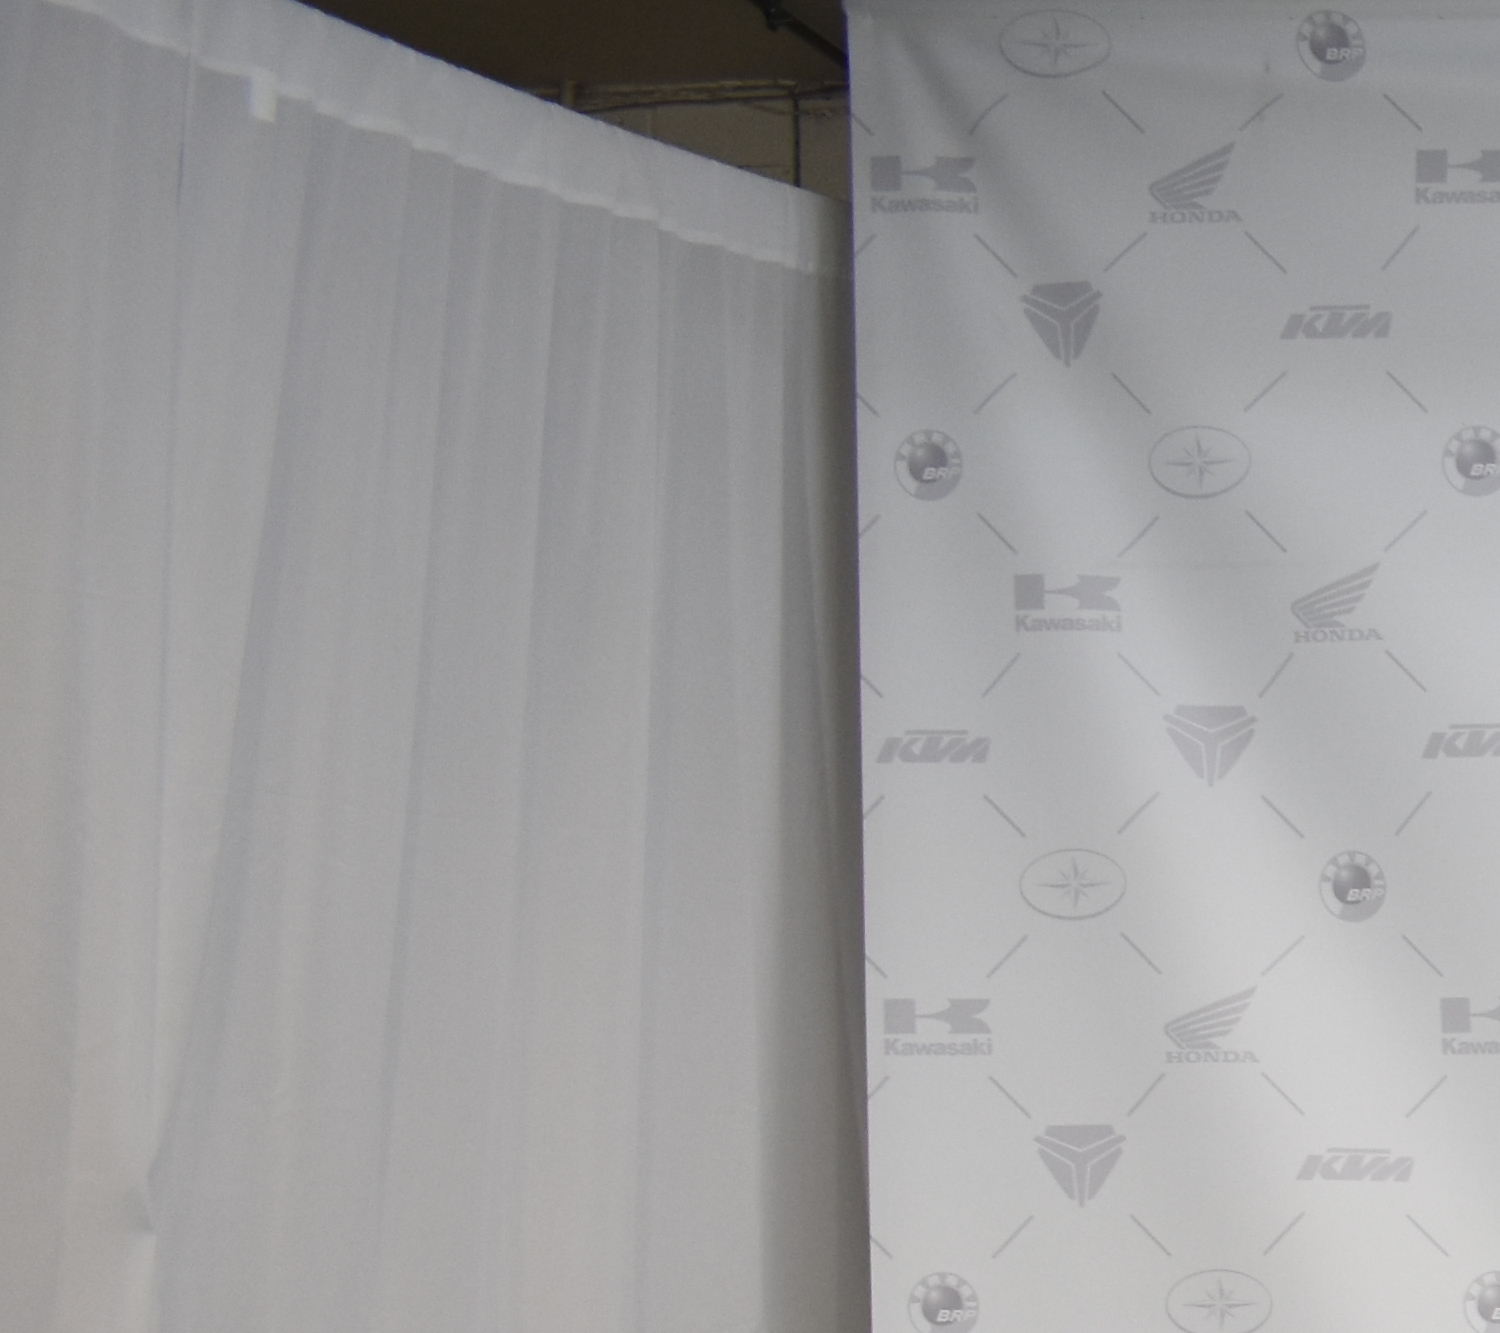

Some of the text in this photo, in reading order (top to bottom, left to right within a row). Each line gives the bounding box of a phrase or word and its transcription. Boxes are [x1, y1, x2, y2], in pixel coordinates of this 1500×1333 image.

[867, 193, 980, 215] Kawasaki
[1149, 208, 1243, 224] HONDA
[1278, 303, 1395, 341] KTM
[1014, 614, 1122, 632] Kawasaki
[1292, 626, 1383, 645] HONDA
[873, 728, 994, 764] KTM
[881, 1036, 994, 1058] Kawasaki
[1165, 1049, 1259, 1064] HONDA
[1295, 1145, 1416, 1185] KTM
